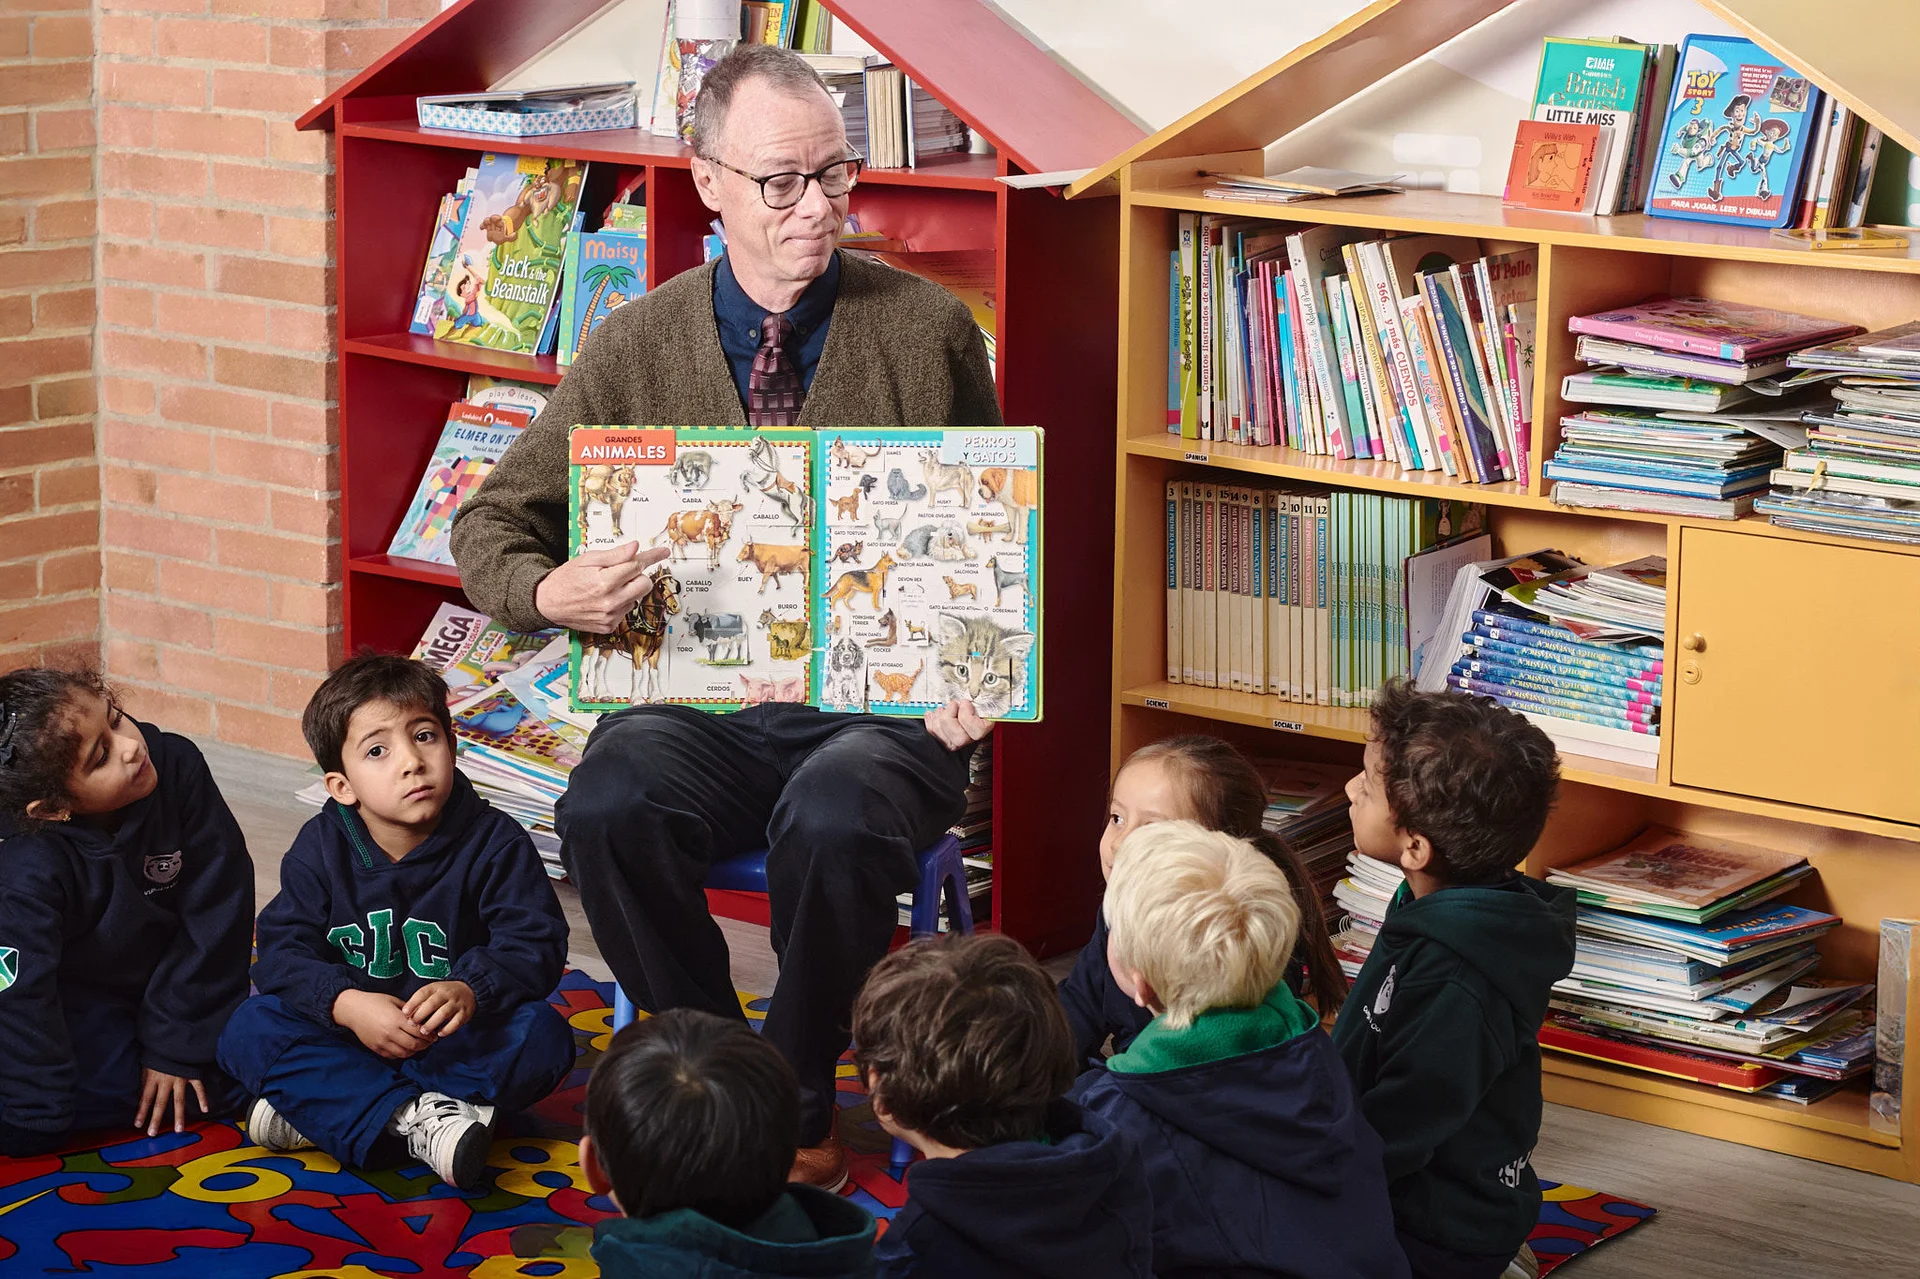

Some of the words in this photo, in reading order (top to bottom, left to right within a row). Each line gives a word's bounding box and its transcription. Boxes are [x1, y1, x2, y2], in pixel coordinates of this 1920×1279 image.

[1565, 72, 1626, 100] British
[1687, 70, 1722, 89] TOY
[1686, 88, 1714, 97] STORY
[1691, 97, 1705, 115] 3
[1546, 109, 1583, 124] LITTLE
[1586, 112, 1616, 125] MISS
[1670, 200, 1689, 208] PARA
[1690, 202, 1718, 212] JUGAR,
[1720, 204, 1737, 213] LEER
[1739, 206, 1744, 214] Y
[1746, 207, 1777, 218] DIBUJAR
[1202, 225, 1210, 257] Pombo
[585, 239, 638, 265] Maisy
[500, 254, 531, 278] Jack
[529, 270, 535, 279] &
[535, 268, 547, 282] the
[1503, 260, 1532, 280] Pollo
[491, 277, 549, 305] Beanstalk
[1300, 277, 1312, 301] Pombo
[1428, 281, 1440, 308] JOYCE
[1202, 291, 1209, 303] de
[1376, 282, 1391, 314] 366...
[1306, 296, 1316, 326] Rafael
[1384, 318, 1393, 326] y
[1388, 326, 1401, 349] más
[1440, 324, 1450, 347] LUNA
[1446, 347, 1454, 358] LA
[1449, 358, 1458, 371] DE
[1396, 349, 1418, 407] CUENTOS
[1453, 372, 1466, 404] HOMBRE
[489, 390, 505, 400] play
[517, 391, 537, 404] learn
[461, 412, 482, 422] Ladybird
[1462, 406, 1469, 416] EL
[454, 428, 487, 444] ELMER
[489, 433, 503, 445] ON
[964, 436, 1016, 449] PERROS
[580, 445, 667, 459] ANIMALES
[963, 452, 969, 460] Y
[972, 452, 1016, 463] GATOS
[1185, 453, 1208, 462] SPANISH
[1169, 488, 1174, 496] 3
[1195, 489, 1201, 498] 5
[1206, 490, 1212, 498] 6
[1220, 490, 1230, 498] 15
[1230, 492, 1239, 501] 14
[1242, 494, 1248, 502] 9
[1253, 496, 1260, 504] 8
[1269, 495, 1276, 503] 7
[1169, 503, 1176, 511] MI
[1195, 504, 1202, 513] MI
[1206, 505, 1213, 514] MI
[1220, 505, 1228, 514] MI
[1231, 508, 1239, 517] MI
[1241, 508, 1249, 518] MI
[1281, 502, 1287, 511] 2
[1290, 504, 1300, 513] 10
[1304, 505, 1313, 513] 11
[1316, 505, 1327, 515] 12
[1253, 511, 1261, 520] MI
[1280, 517, 1287, 526] MI
[1220, 514, 1228, 544] PRIMERA
[1291, 519, 1298, 528] MI
[1318, 520, 1325, 529] MI
[1231, 517, 1239, 546] PRIMERA
[1241, 518, 1249, 549] PRIMERA
[1253, 520, 1261, 550] PRIMERA
[1220, 544, 1228, 589] ENCICLOPEDIA
[1231, 547, 1239, 591] ENCICLOPEDIA
[1241, 549, 1249, 593] ENCICLOPEDIA
[1253, 551, 1261, 595] ENCICLOPEDIA
[468, 619, 482, 643] COLORES
[423, 615, 475, 666] MEGA
[1146, 699, 1168, 708] SCIENCE
[1273, 720, 1293, 729] SOCIAL
[326, 908, 451, 980] CLC
